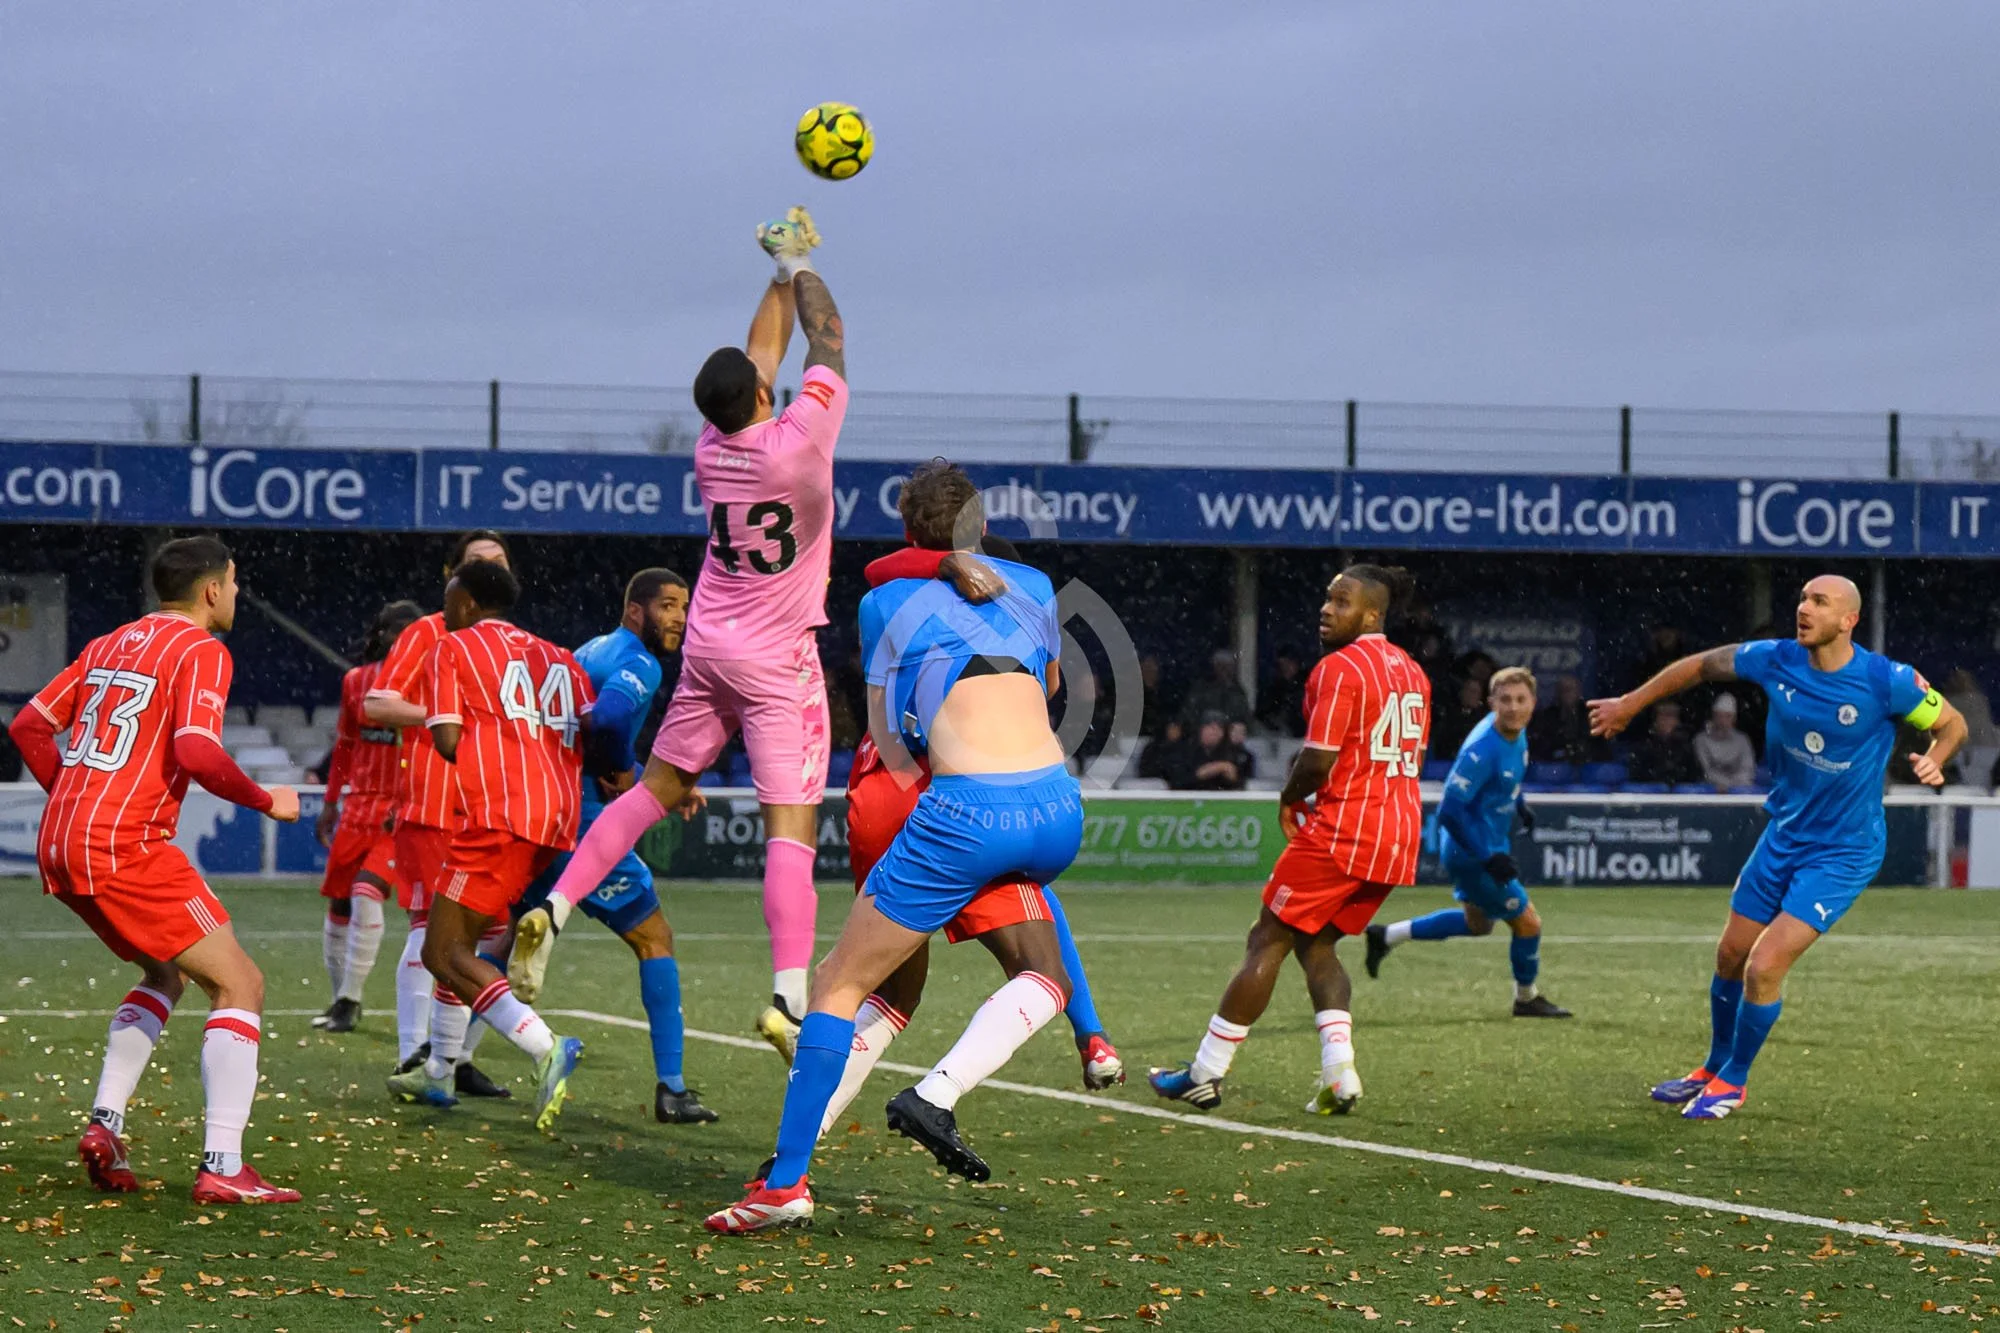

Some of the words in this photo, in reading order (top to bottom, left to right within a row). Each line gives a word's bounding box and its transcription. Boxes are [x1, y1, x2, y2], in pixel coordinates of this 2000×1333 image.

[190, 448, 364, 520] iCore
[440, 464, 483, 509] IT
[502, 466, 661, 514] Service
[878, 474, 1138, 535] Cultancy
[1200, 483, 1676, 537] www.icore-ltd.com
[1738, 479, 1895, 547] iCore
[1951, 496, 1989, 539] IT
[710, 501, 798, 575] 43
[62, 667, 158, 772] 33
[500, 660, 580, 748] 44
[1370, 691, 1424, 778] 45
[1137, 815, 1262, 848] 676660
[1543, 845, 1702, 880] hill.co.uk
